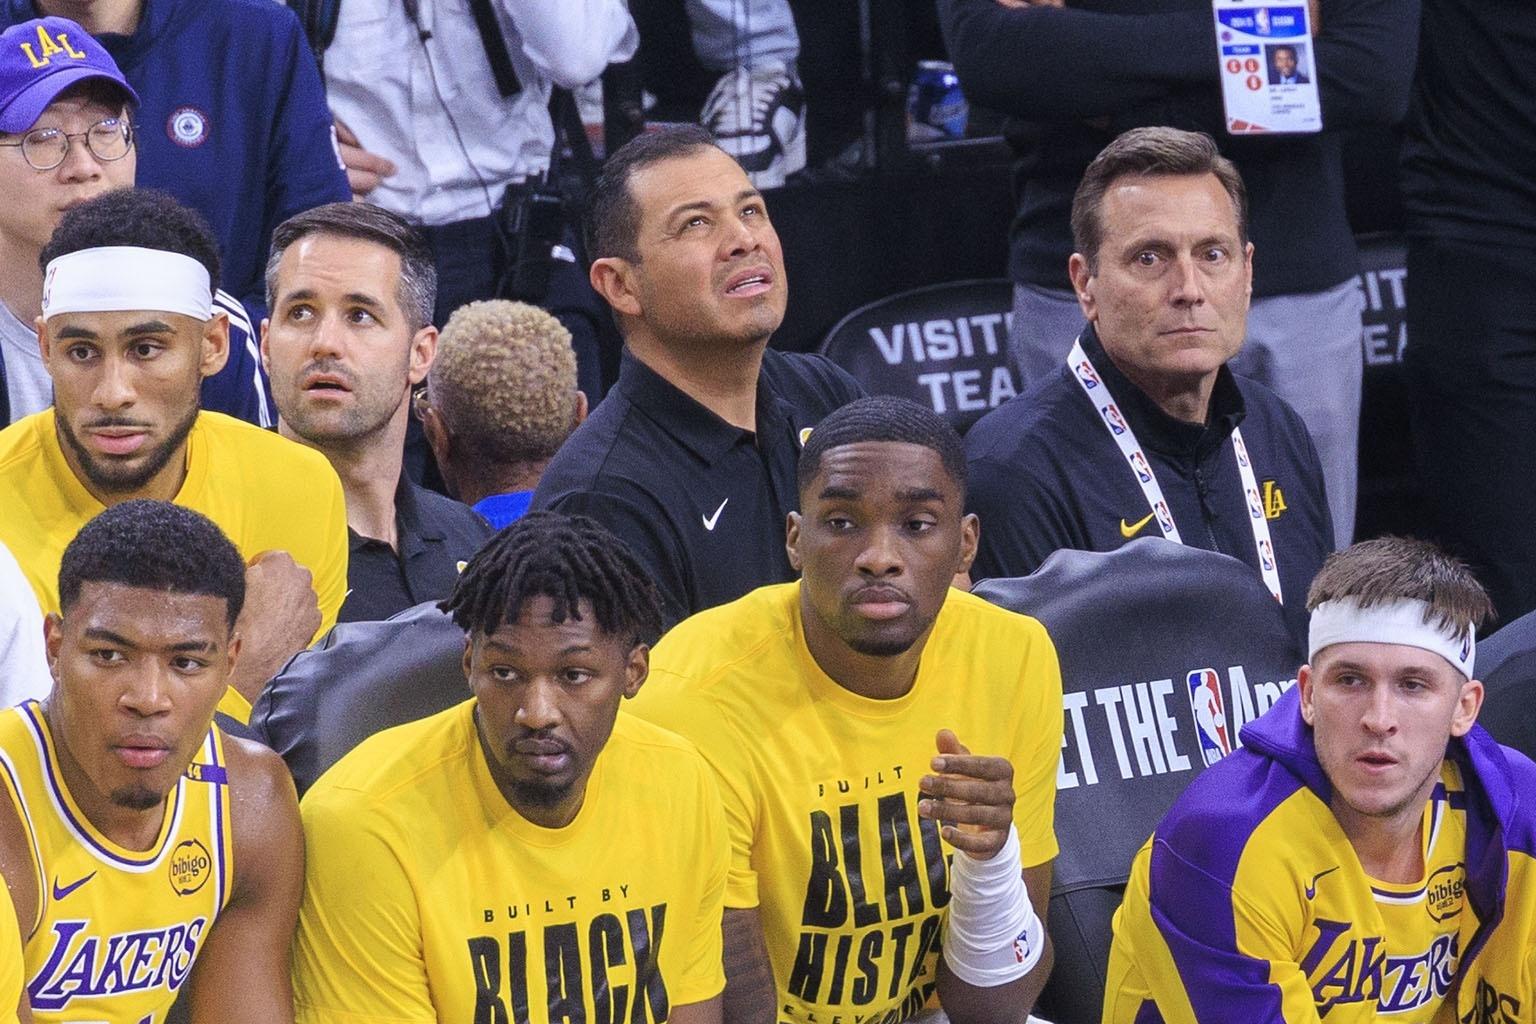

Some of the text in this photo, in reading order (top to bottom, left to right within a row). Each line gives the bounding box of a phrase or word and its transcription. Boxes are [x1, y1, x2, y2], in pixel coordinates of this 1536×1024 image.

[21, 25, 85, 69] LAL
[868, 311, 1015, 365] VISIT
[1263, 480, 1288, 519] LA
[1094, 679, 1192, 780] THE
[819, 766, 903, 797] BUILT
[172, 854, 208, 878] bibigo
[484, 884, 629, 923] BUILT BY
[1428, 879, 1464, 906] bibig
[27, 917, 208, 1011] LAKERS
